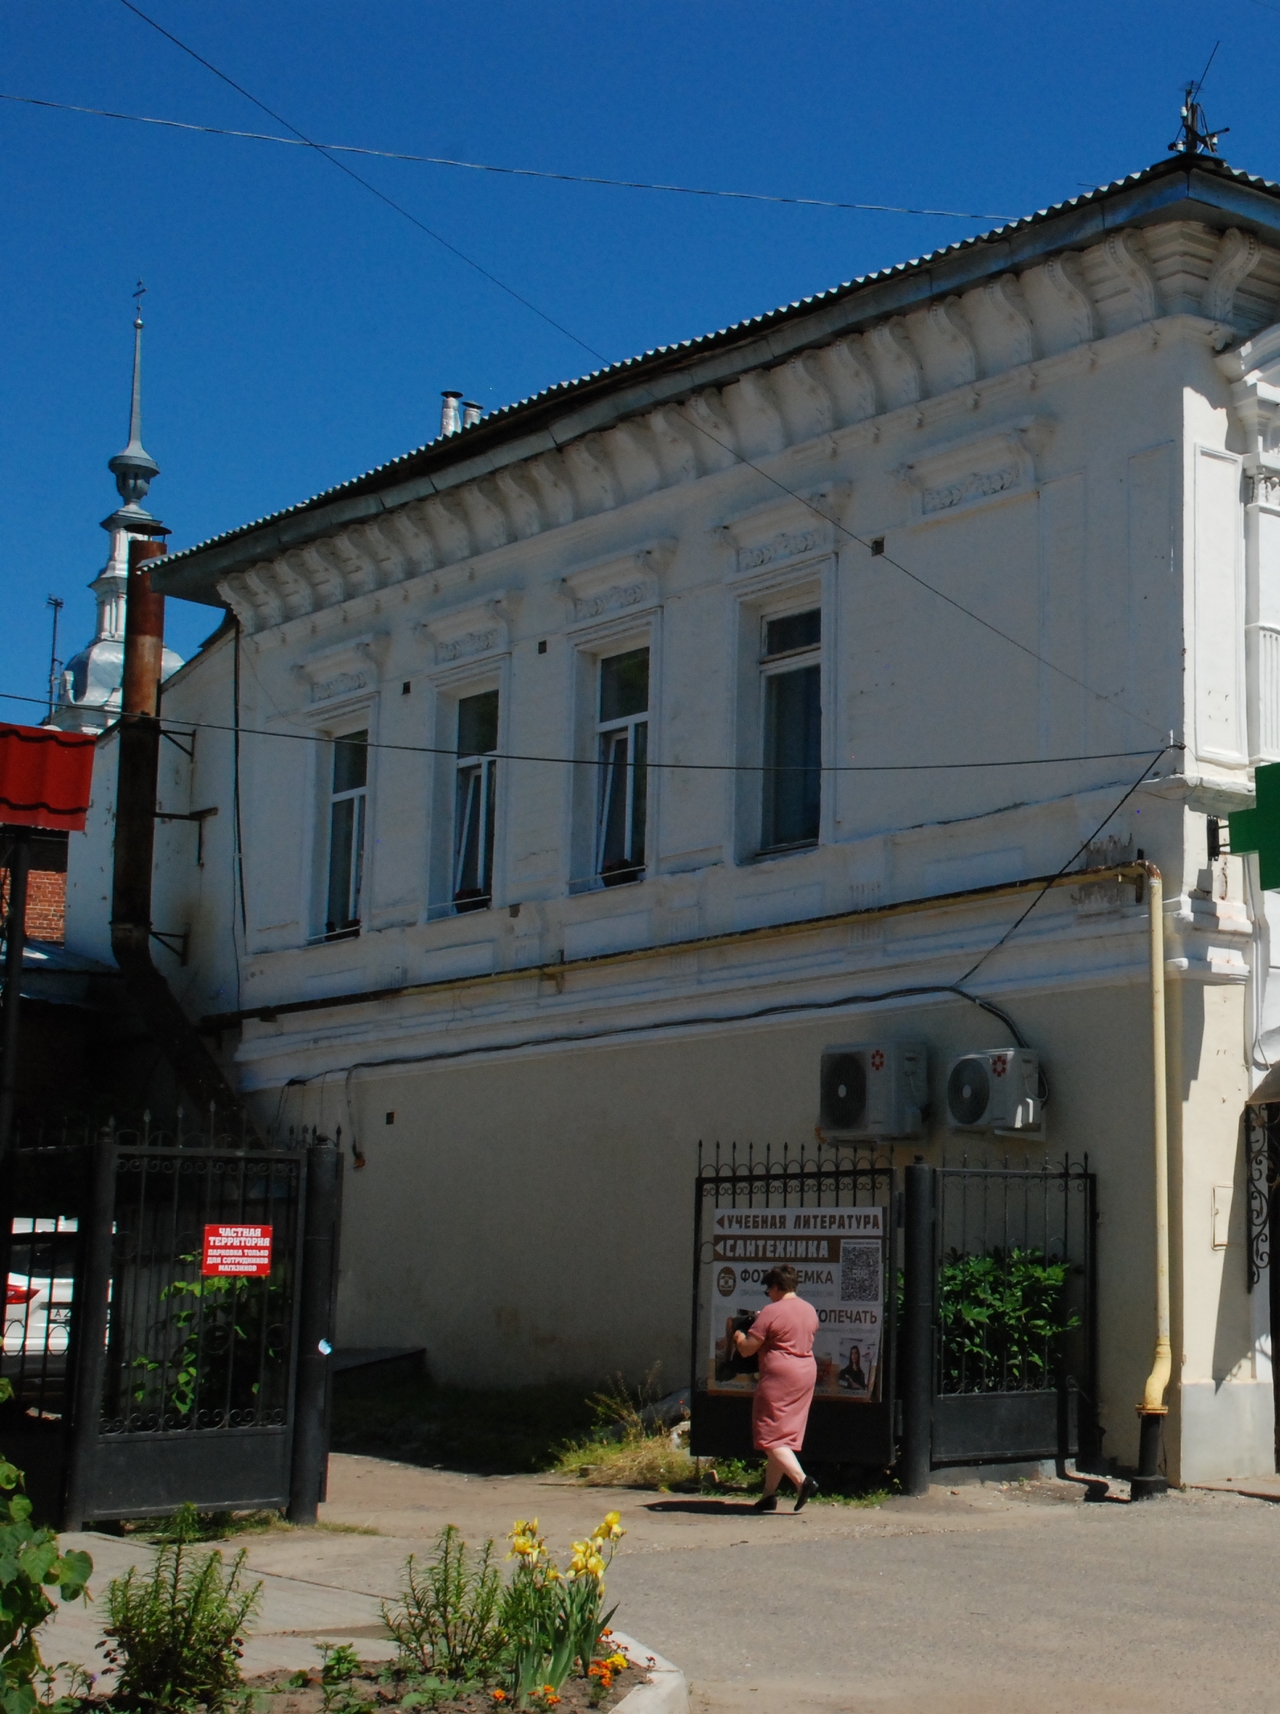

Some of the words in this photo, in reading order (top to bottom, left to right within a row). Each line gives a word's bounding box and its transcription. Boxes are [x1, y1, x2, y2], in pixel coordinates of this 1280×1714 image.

[726, 1214, 787, 1229] УЧЕБНАЯ
[794, 1214, 880, 1229] ЛИТЕРАТУРА
[219, 1227, 262, 1236] ЧАСТНАЯ
[208, 1237, 270, 1246] ТЕРРИТОРИЯ
[725, 1239, 829, 1258] САНТЕХНИКА
